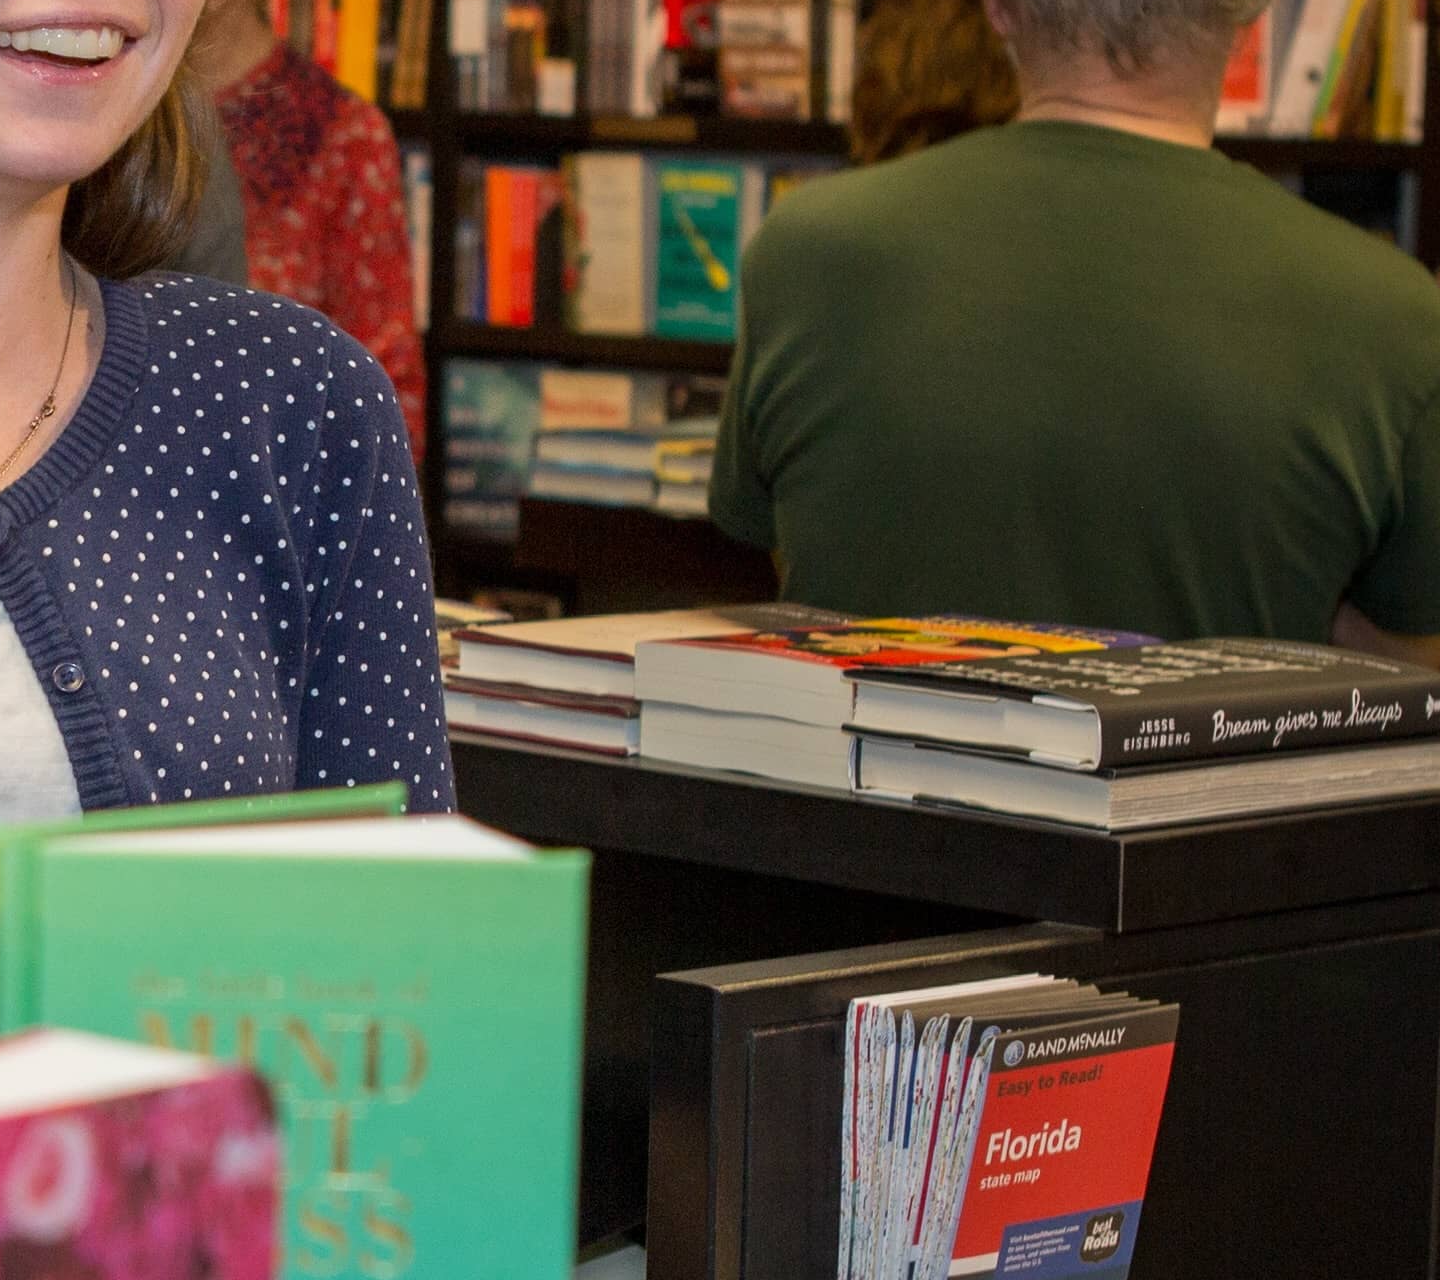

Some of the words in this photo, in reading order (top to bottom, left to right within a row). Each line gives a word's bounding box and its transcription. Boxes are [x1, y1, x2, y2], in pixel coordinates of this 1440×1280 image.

[1139, 718, 1176, 734] JESSE
[1212, 709, 1271, 743] Bream
[1273, 711, 1318, 747] gives
[1322, 710, 1342, 729] me
[1345, 688, 1403, 732] hiccups
[1124, 732, 1191, 751] EISENBERG
[1027, 1037, 1067, 1059] RAND
[997, 1079, 1032, 1097] Easy
[1038, 1074, 1055, 1090] to
[1059, 1064, 1104, 1085] Read!
[985, 1118, 1082, 1166] Florida
[980, 1173, 1012, 1191] state
[1013, 1168, 1041, 1185] map
